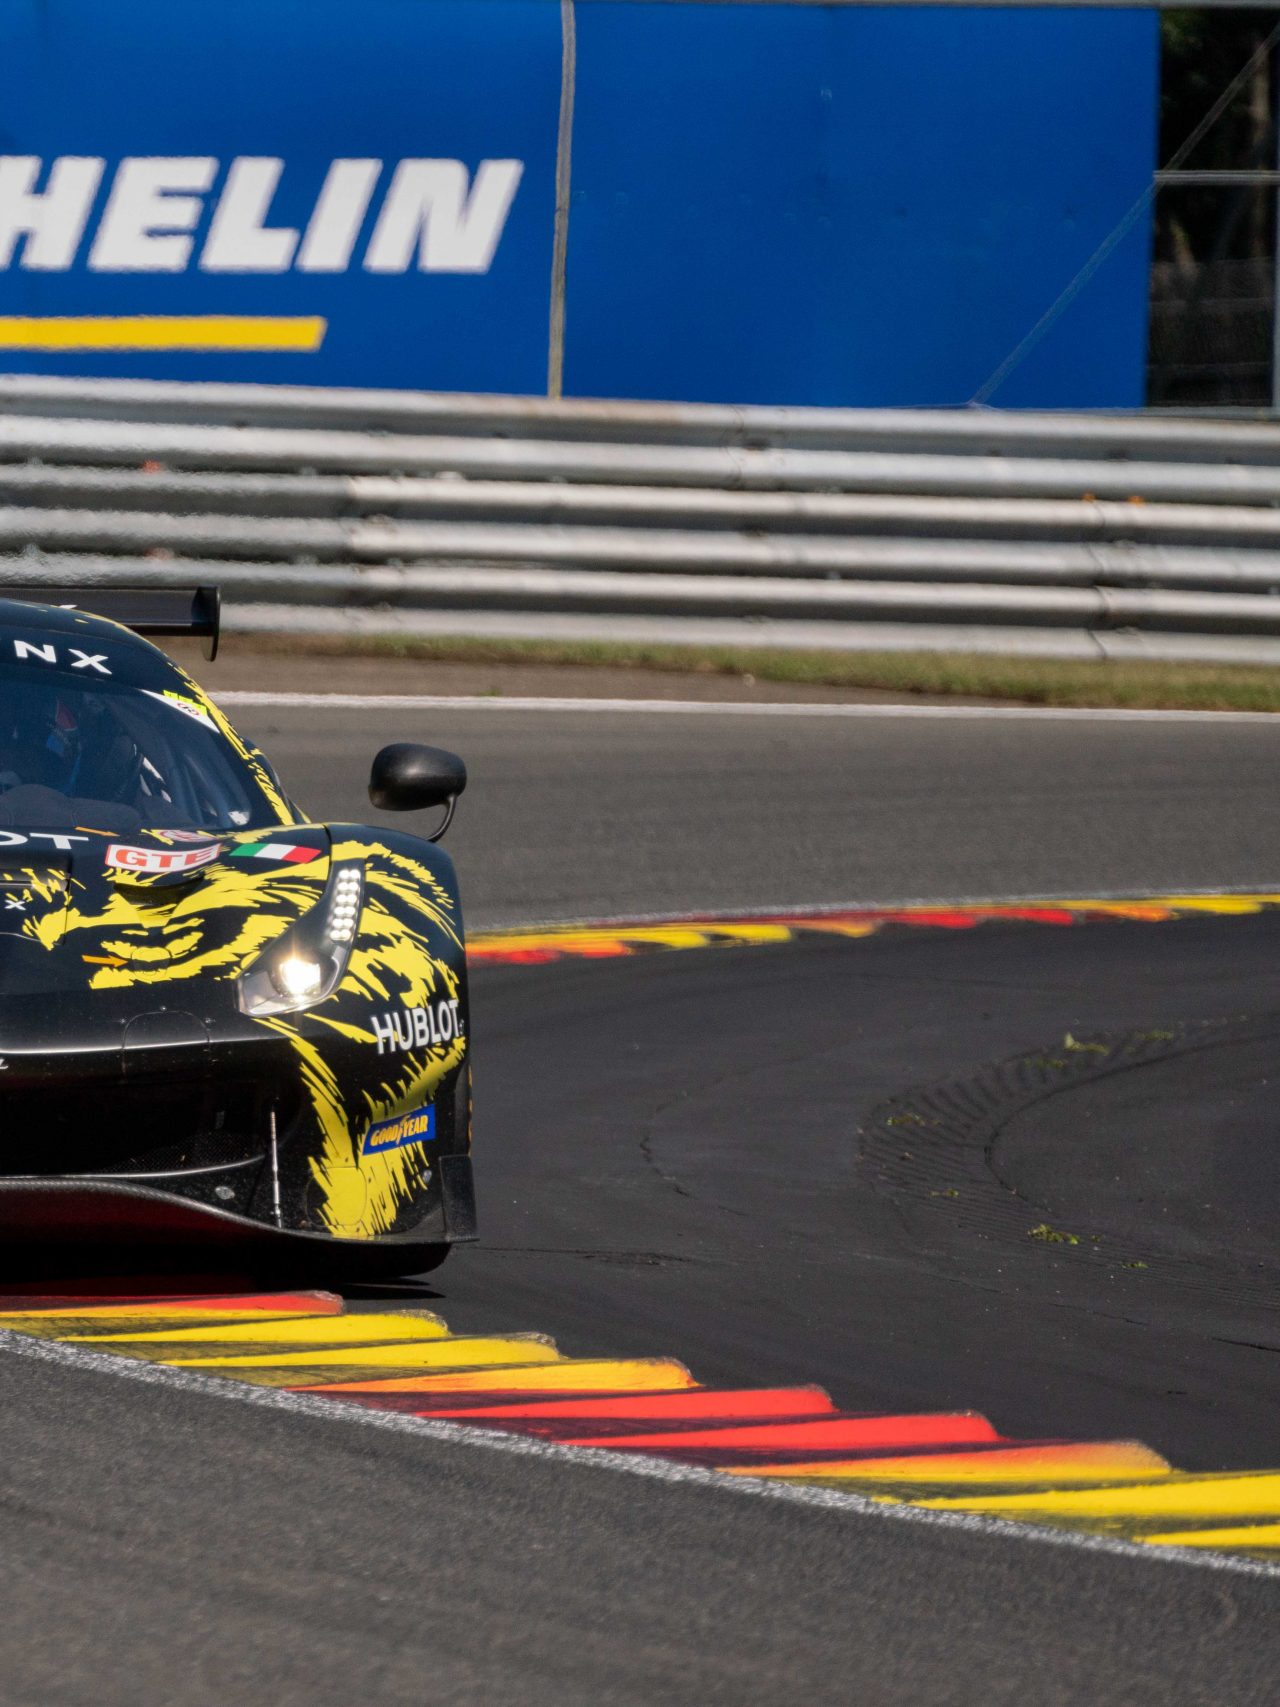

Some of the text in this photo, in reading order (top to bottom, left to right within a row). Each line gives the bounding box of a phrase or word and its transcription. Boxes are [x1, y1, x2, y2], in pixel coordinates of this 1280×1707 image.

[115, 846, 212, 868] GTE
[371, 1000, 460, 1054] HUBLOT
[371, 1114, 429, 1146] GOODYEAR
